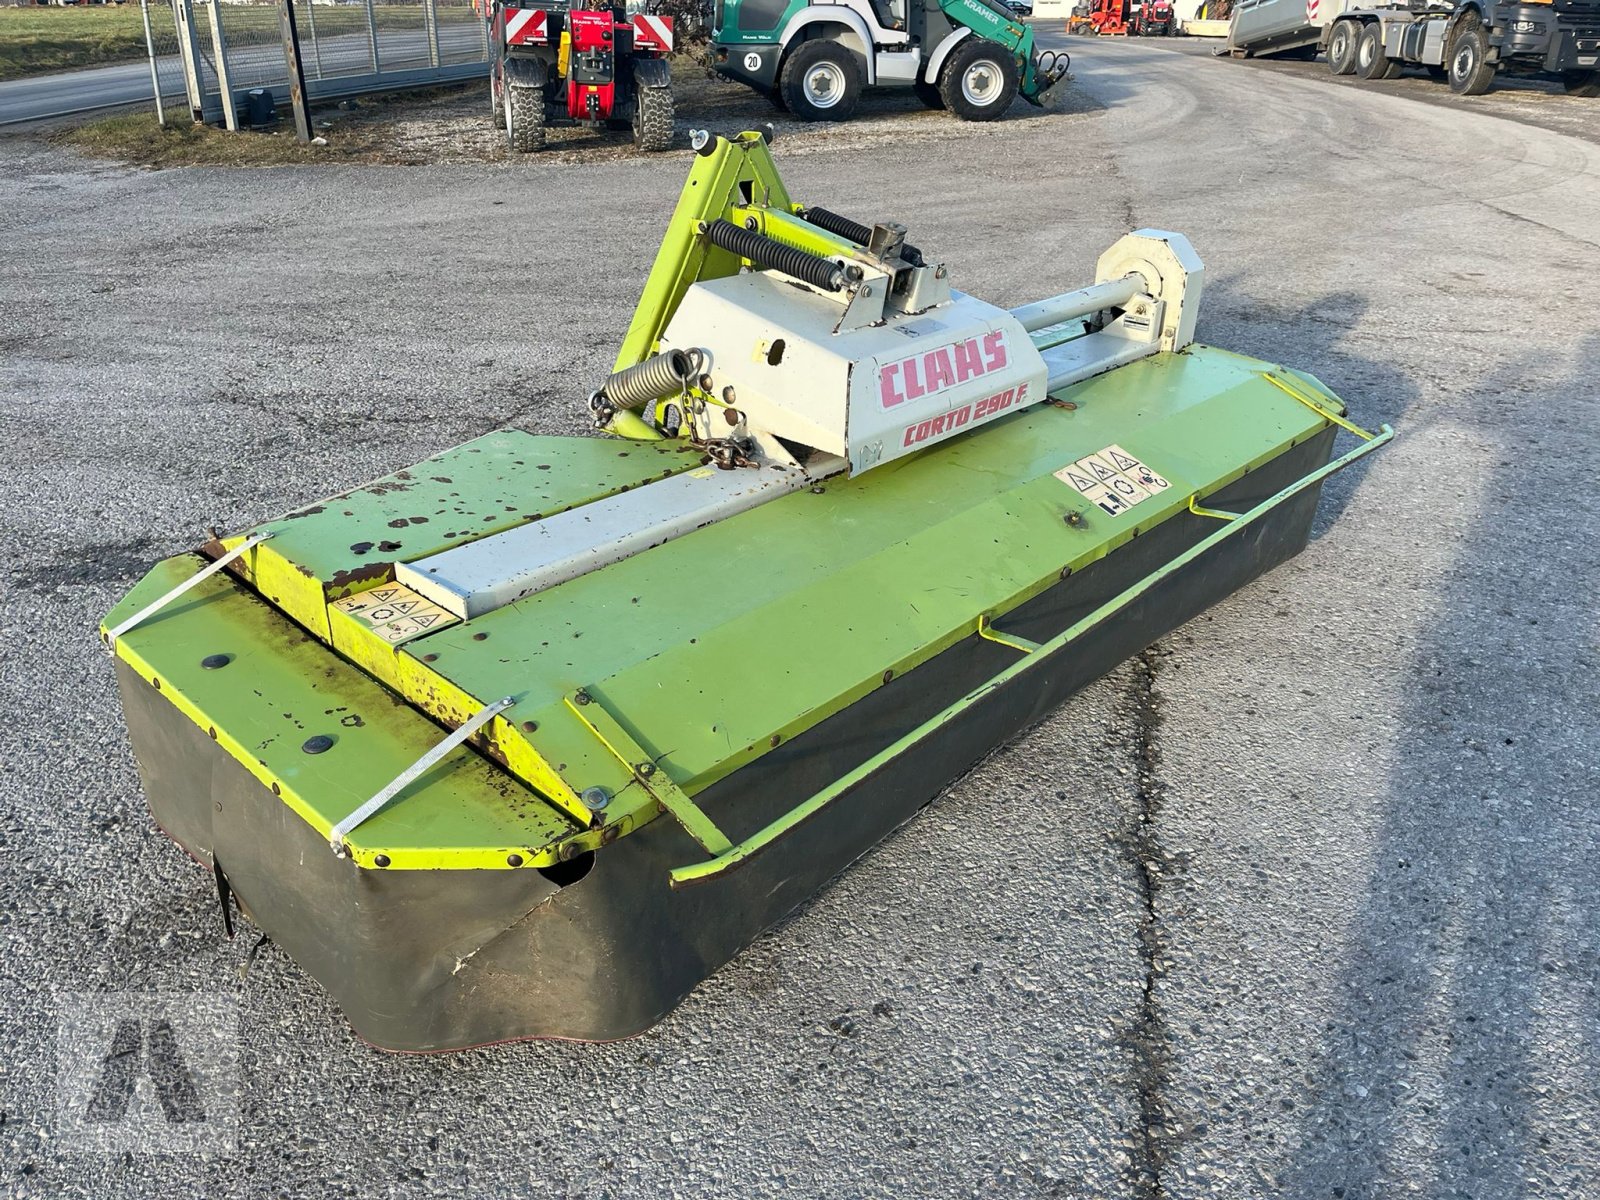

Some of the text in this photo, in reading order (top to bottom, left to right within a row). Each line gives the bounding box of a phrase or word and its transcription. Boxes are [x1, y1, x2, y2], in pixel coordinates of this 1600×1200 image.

[963, 0, 999, 25] KRAMER
[748, 56, 758, 67] 20
[880, 331, 1007, 409] CLAAS
[903, 383, 1029, 447] CORTO 290 F
